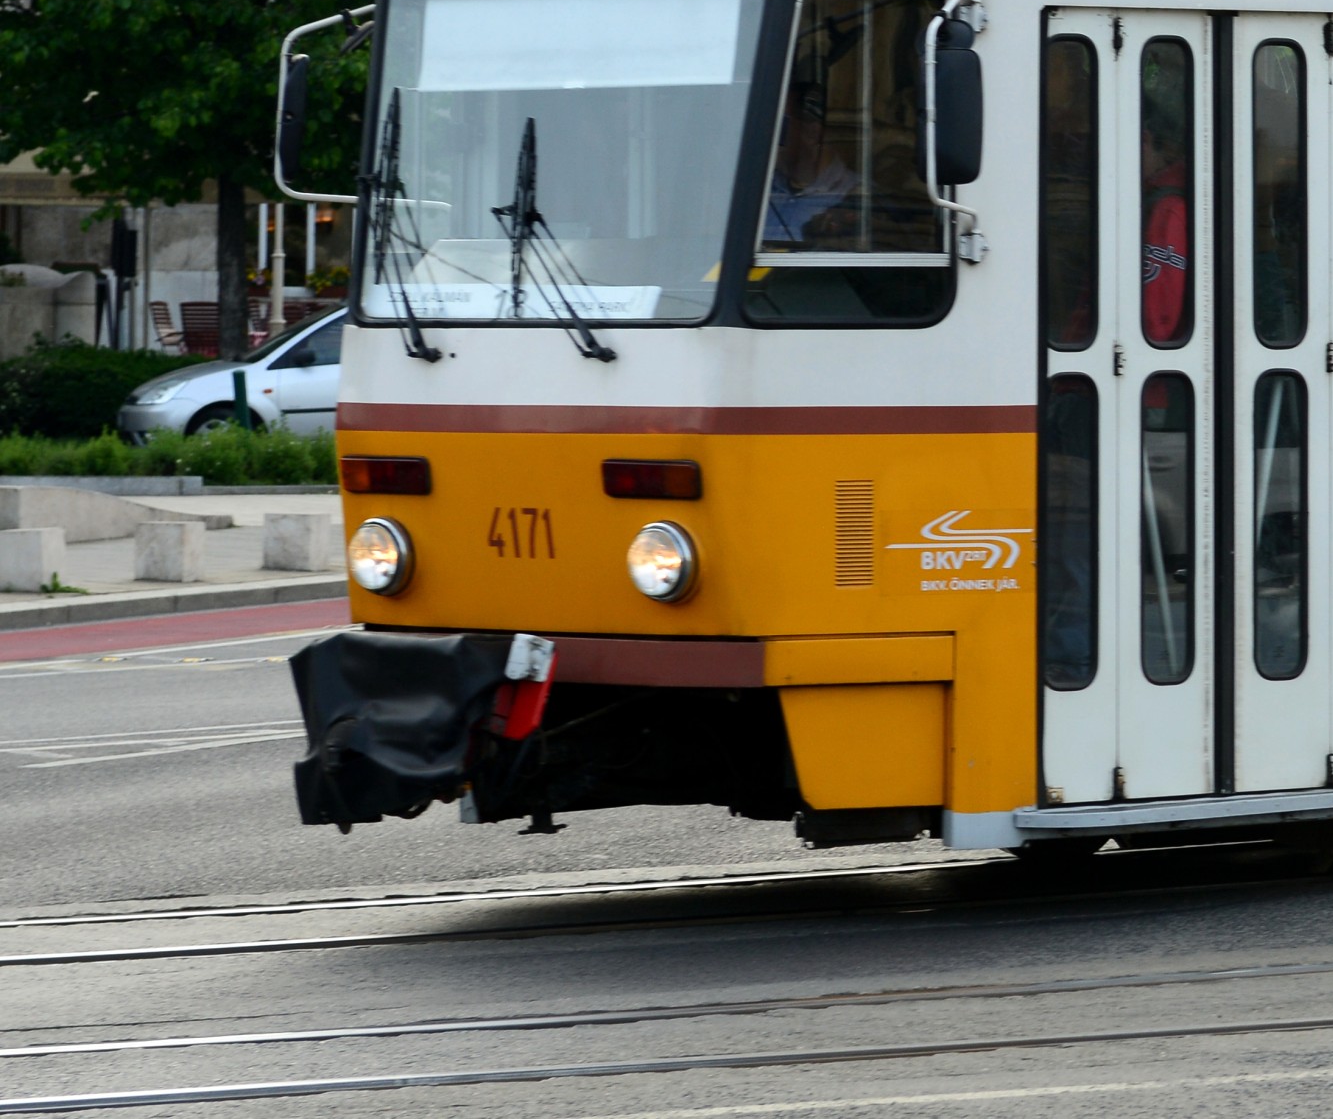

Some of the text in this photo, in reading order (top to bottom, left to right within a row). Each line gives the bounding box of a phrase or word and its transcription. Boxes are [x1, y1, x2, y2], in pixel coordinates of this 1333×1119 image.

[487, 507, 555, 559] 4171
[920, 551, 964, 570] BKV
[920, 576, 1020, 592] BKV. ÖNNEK JÁR.
